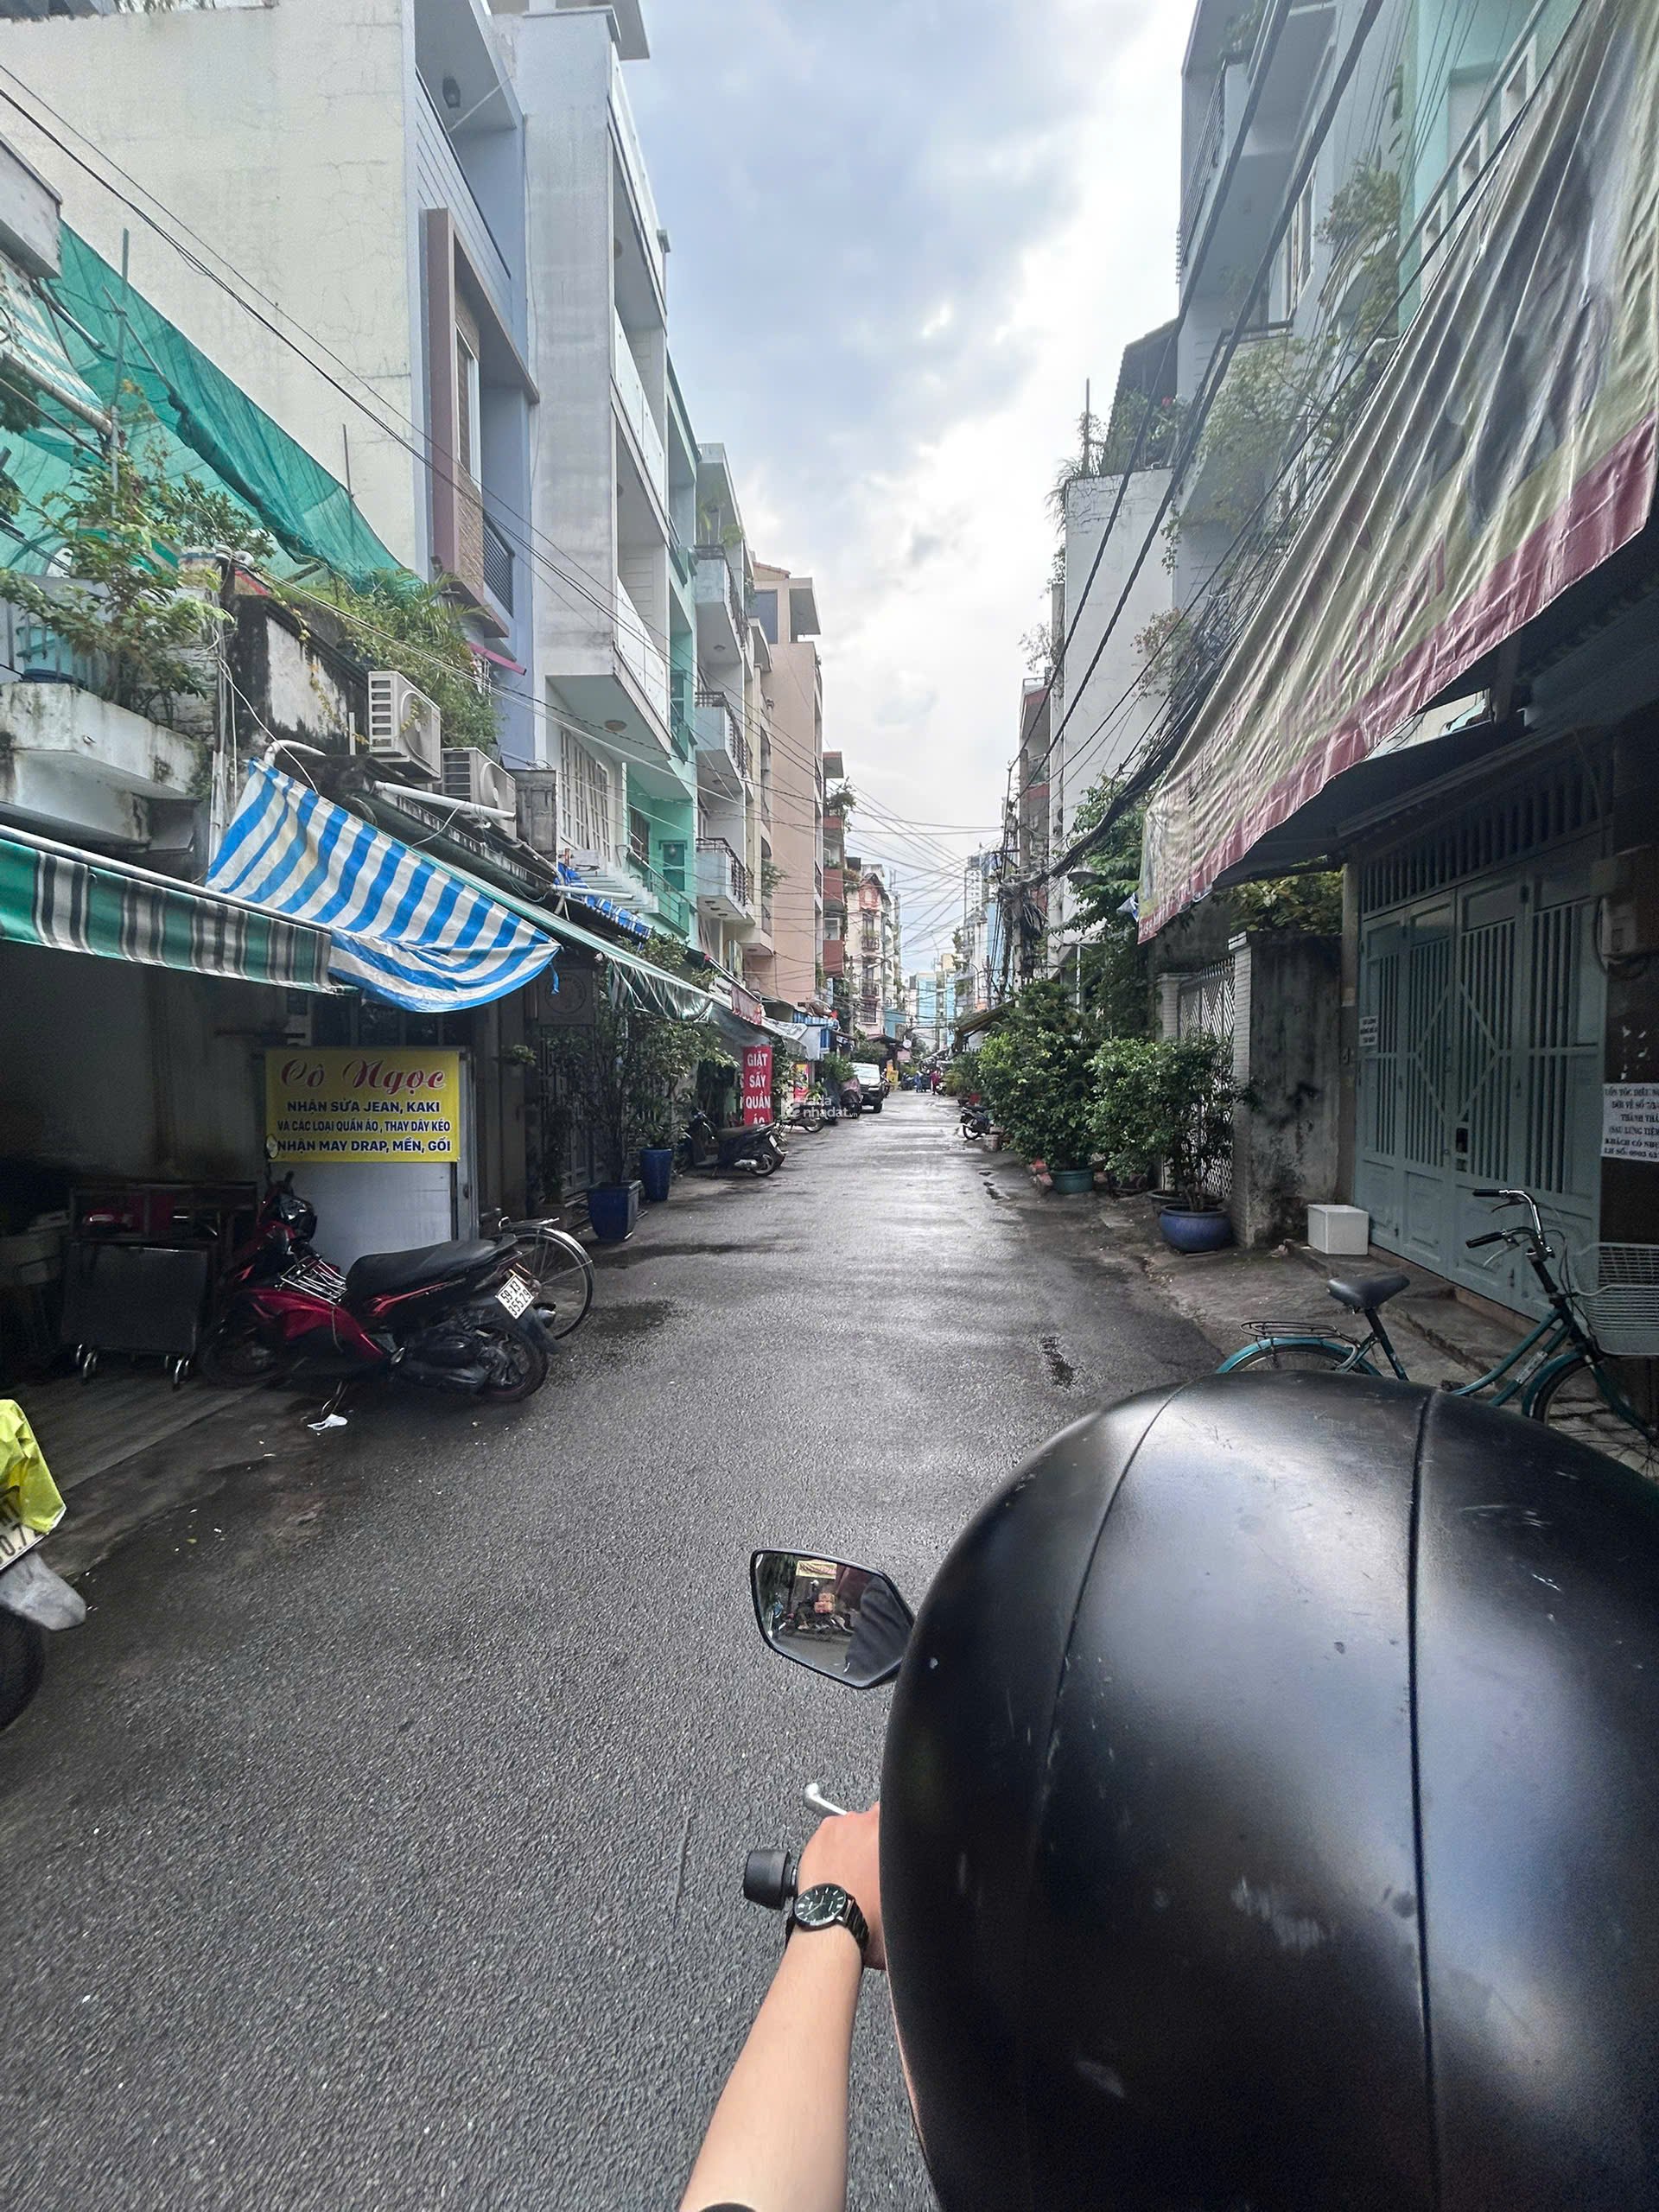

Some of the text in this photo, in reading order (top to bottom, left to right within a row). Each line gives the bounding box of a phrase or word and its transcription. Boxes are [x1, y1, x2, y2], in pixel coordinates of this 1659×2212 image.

[281, 1058, 446, 1096] Cô Ngọc
[749, 1071, 766, 1089] SẤY
[364, 1102, 404, 1114] JEAN,
[406, 1102, 440, 1112] KAKI
[746, 1092, 771, 1109] QUẦN
[385, 1121, 409, 1131] THAY
[410, 1118, 429, 1131] DÂY
[432, 1118, 450, 1131] KÉO
[319, 1141, 347, 1151] MAY
[351, 1141, 390, 1154] DRAP,
[428, 1135, 450, 1151] GỐI
